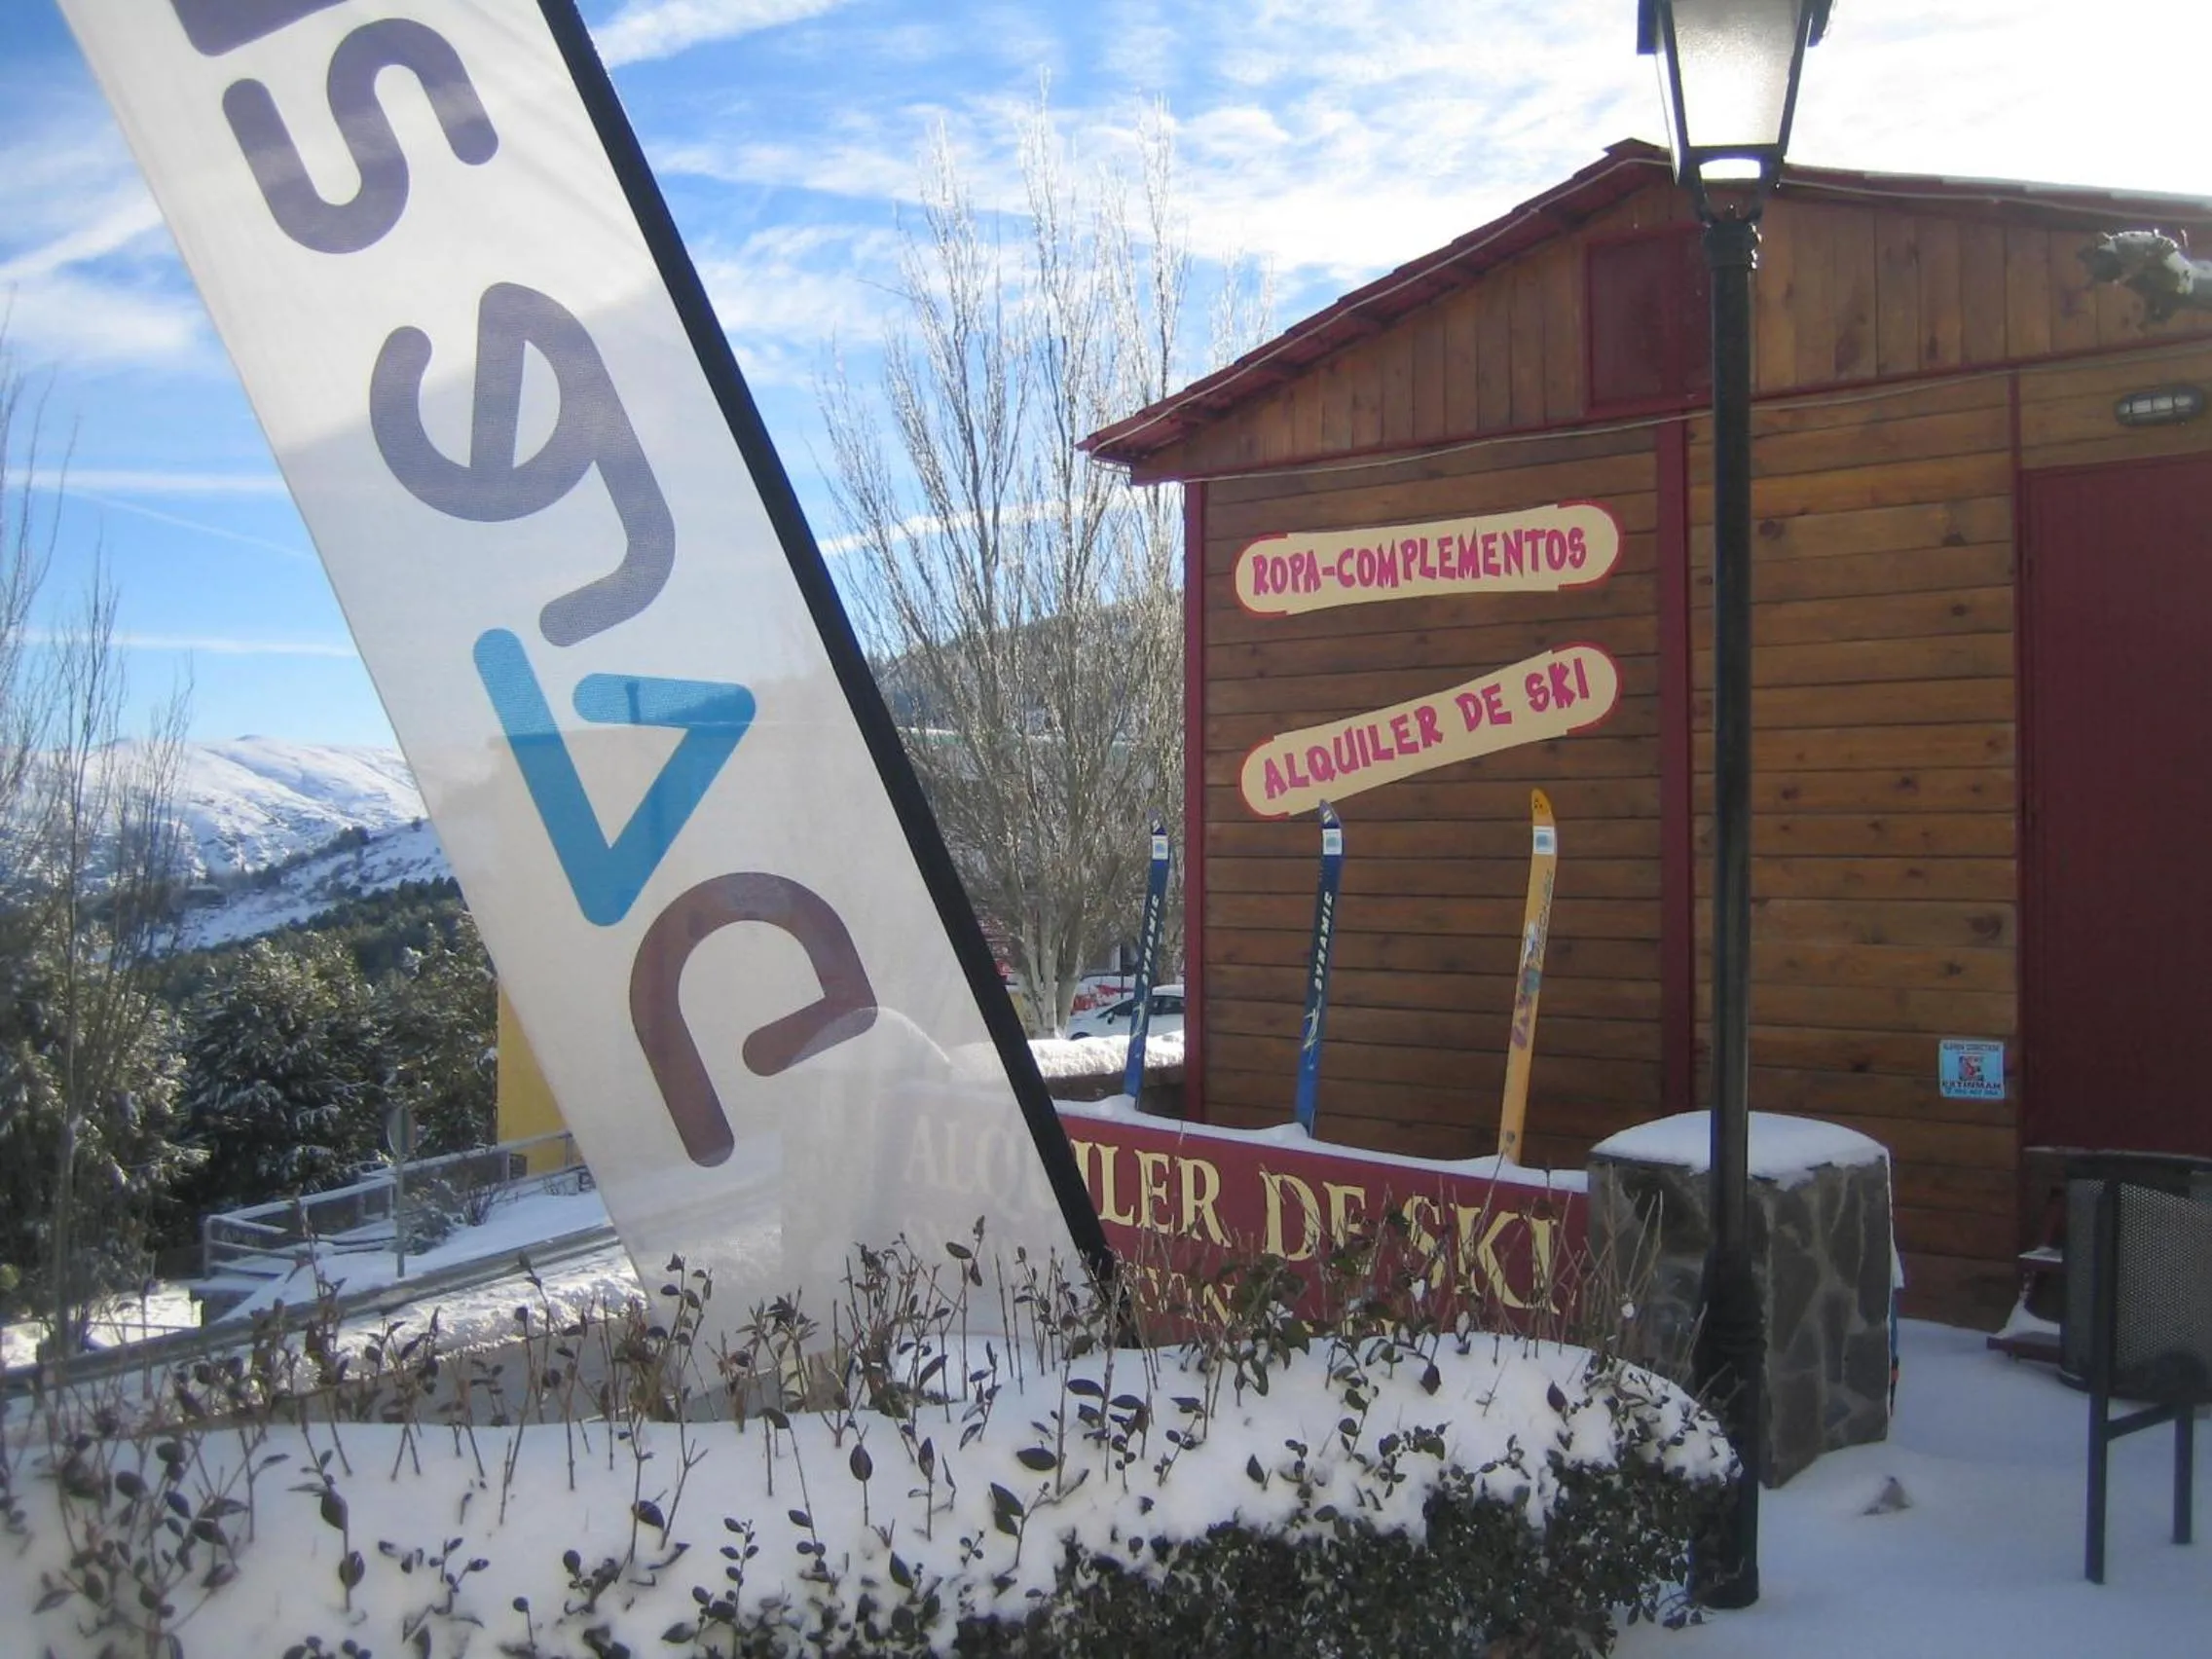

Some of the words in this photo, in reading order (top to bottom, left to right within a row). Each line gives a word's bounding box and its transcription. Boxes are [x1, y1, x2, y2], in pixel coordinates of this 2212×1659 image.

[1252, 526, 1587, 596] ROPA-COMPLEMENTOS
[1265, 705, 1444, 799] ALQUILER
[1455, 683, 1512, 732] DE
[1525, 657, 1589, 713] SKI
[1260, 1170, 1371, 1275] DE
[1403, 1195, 1561, 1314] SKI
